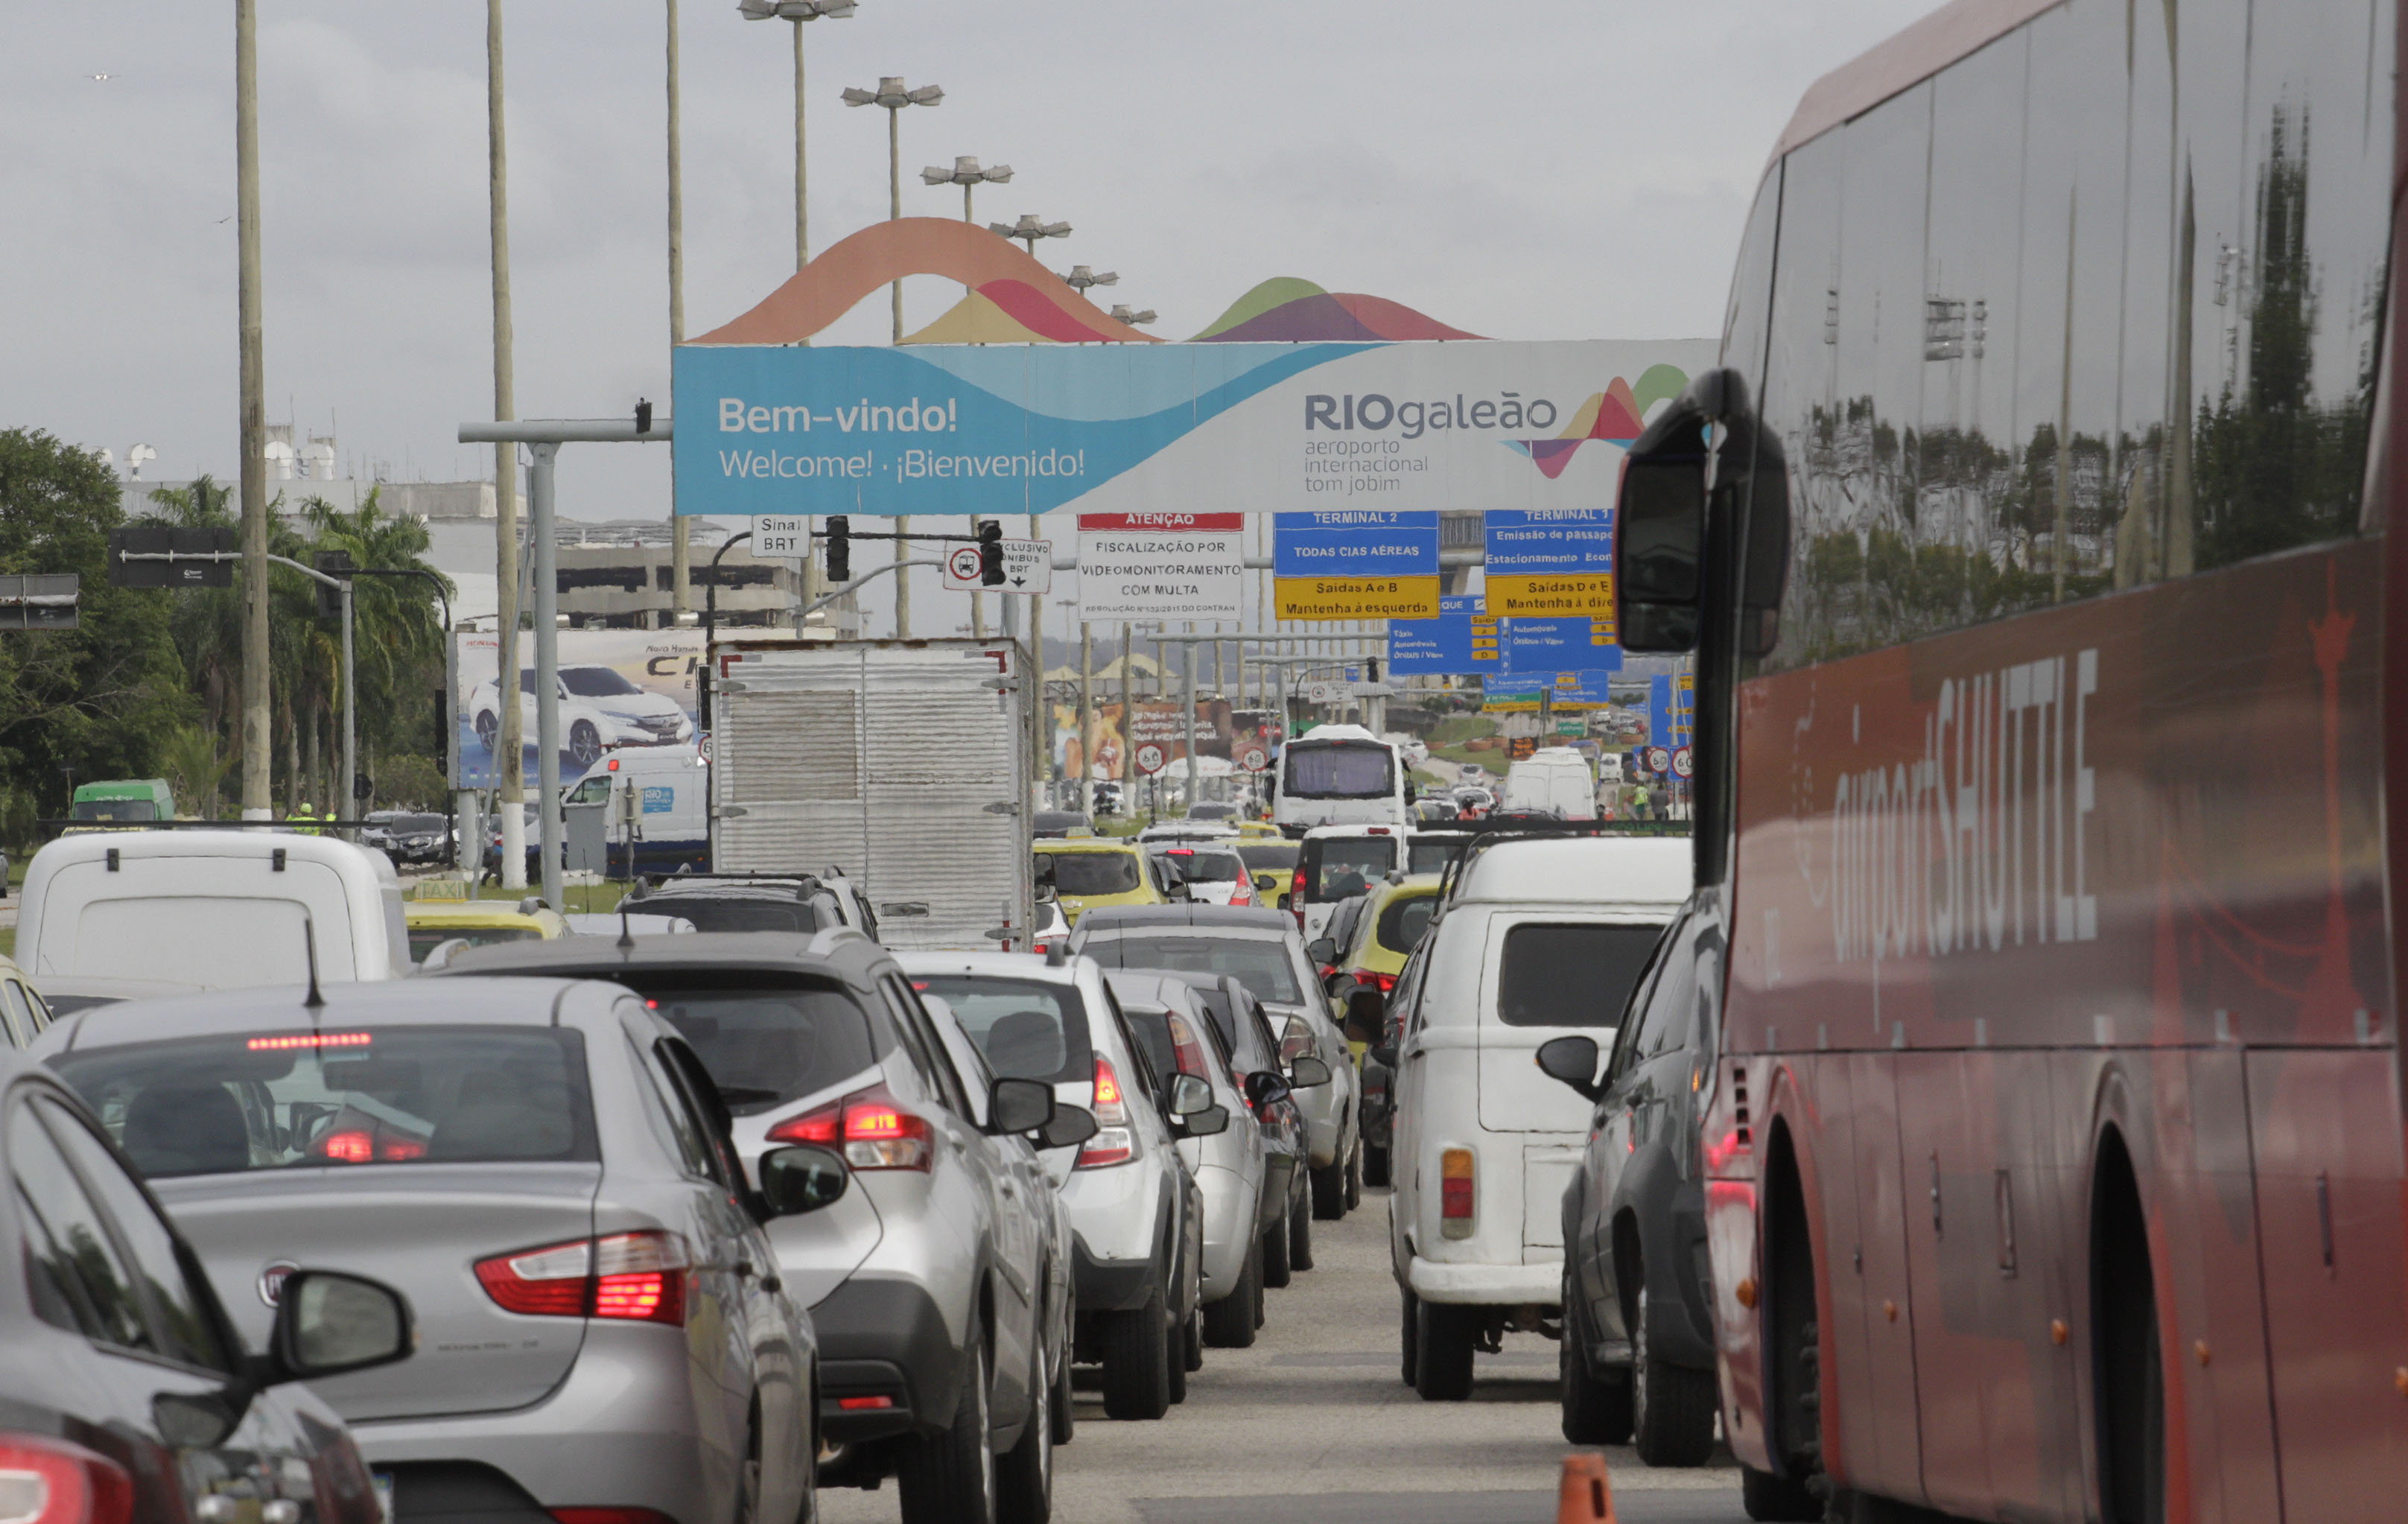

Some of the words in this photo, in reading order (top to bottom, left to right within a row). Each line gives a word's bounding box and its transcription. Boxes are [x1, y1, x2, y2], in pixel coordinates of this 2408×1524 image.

[719, 397, 956, 433] Bem-vindo!
[1305, 391, 1557, 439] RIOgaleão
[1306, 438, 1400, 458] aeroporto
[719, 449, 872, 477] Welcome!
[898, 448, 1084, 483] ¡Bienvenido!
[1305, 456, 1428, 473] internacional
[1306, 477, 1342, 492] tom
[1348, 474, 1400, 495] jobim
[1314, 512, 1385, 524] TERMINAL
[1390, 512, 1397, 523] 2
[1525, 509, 1597, 521] TERMINAL
[1602, 509, 1609, 519] 1
[762, 518, 800, 530] Sinal
[1496, 530, 1545, 541] Emissão
[1549, 530, 1563, 539] de
[764, 538, 797, 550] BRT
[1096, 540, 1194, 553] FISCALIZAÇÃO
[1198, 542, 1225, 552] POR
[1294, 547, 1335, 557] TODAS
[1340, 547, 1367, 557] CIAS
[1370, 544, 1420, 556] AÉREAS
[1487, 553, 1578, 564] Estacionamento
[1081, 565, 1241, 575] VIDEOMONITORAMENTO
[1122, 585, 1150, 595] COM
[1155, 585, 1198, 595] MULTA
[1365, 583, 1374, 593] A
[1389, 582, 1397, 592] B
[1578, 582, 1585, 592] D
[1601, 581, 1609, 592] E
[1286, 603, 1351, 614] Mantenha
[1365, 603, 1428, 615] esquerda
[1439, 601, 1463, 609] QUE
[1508, 598, 1572, 609] Mantenha
[419, 881, 463, 898] TAXI
